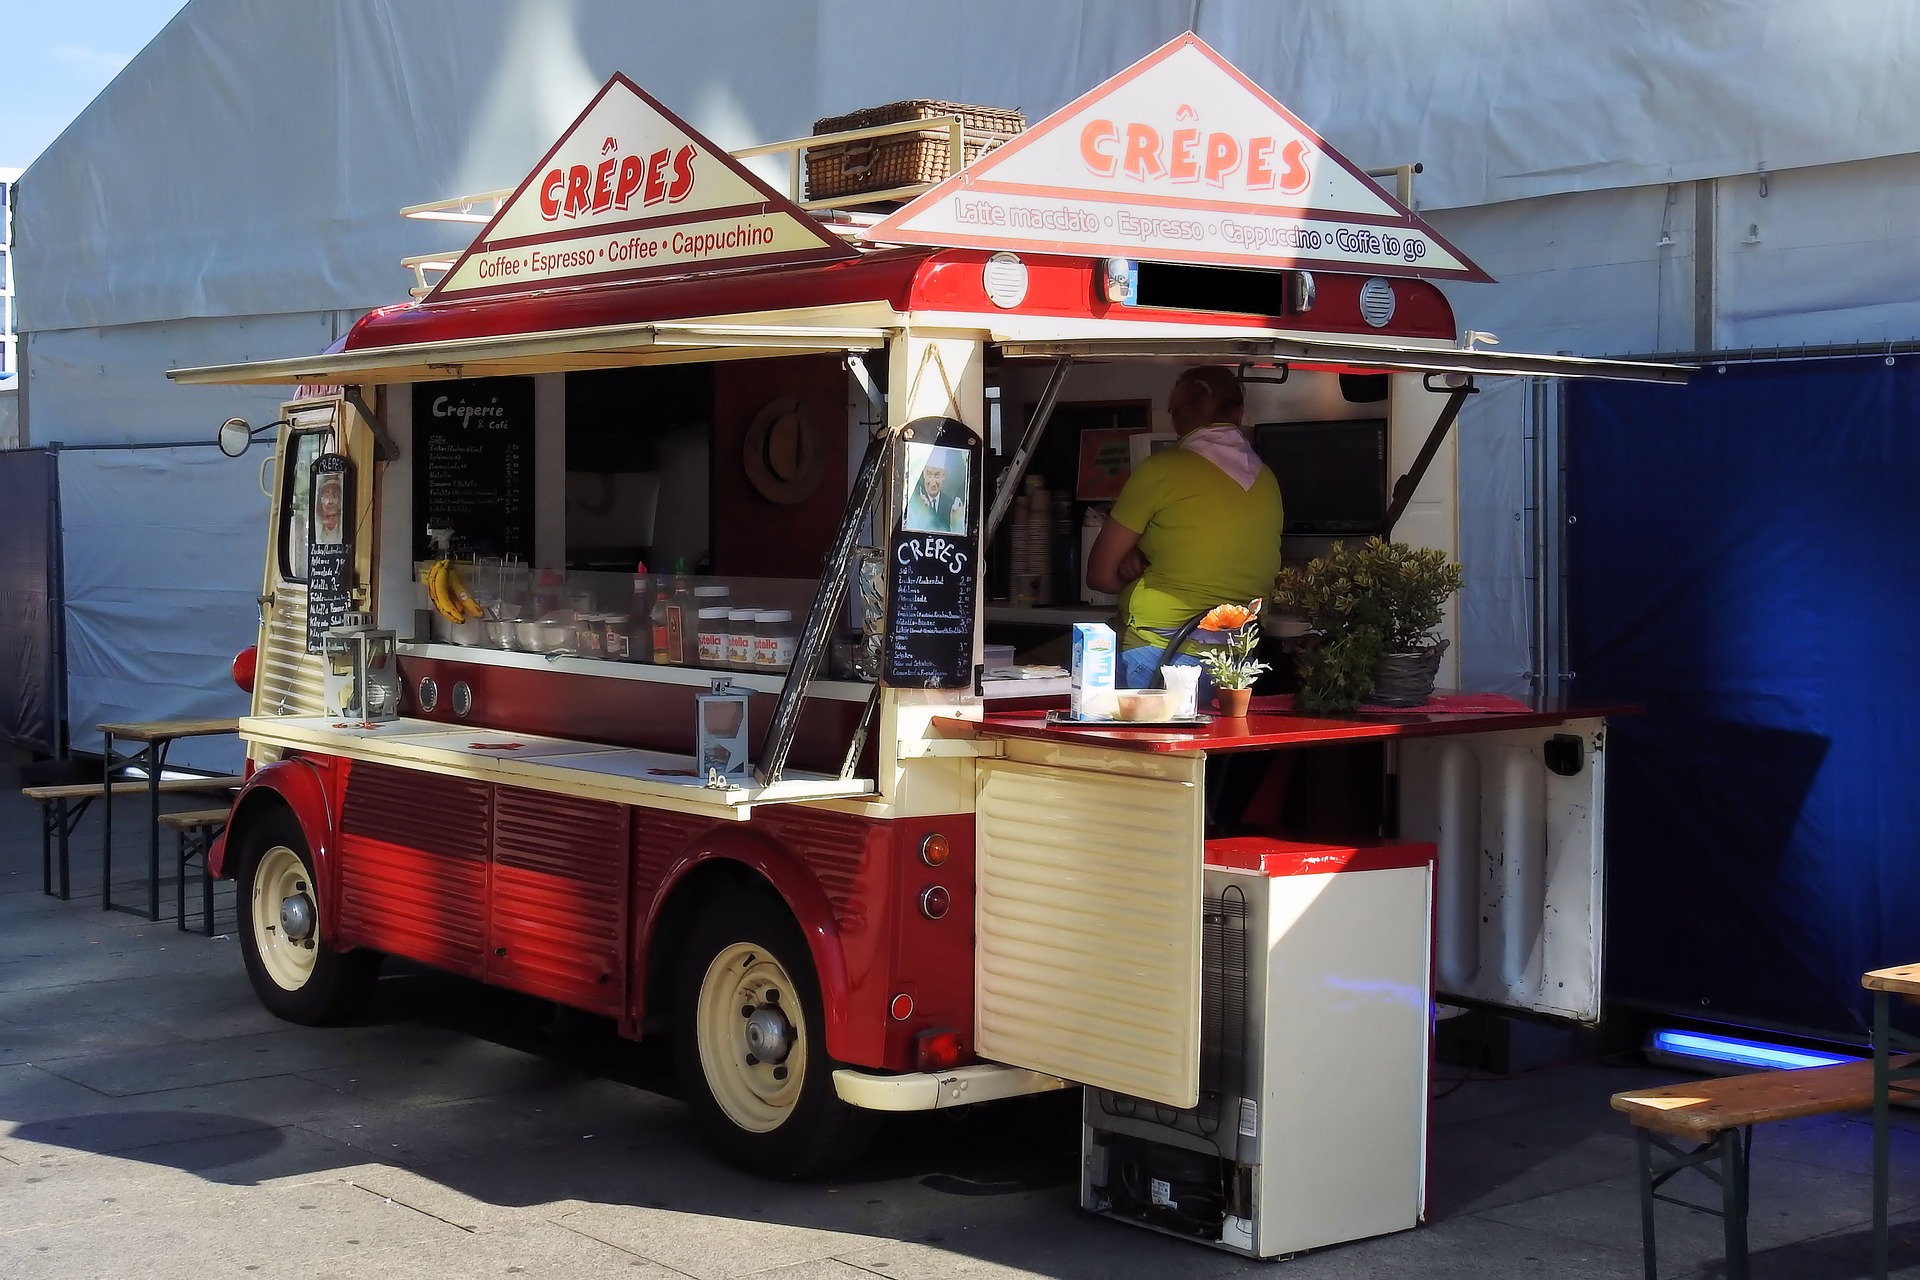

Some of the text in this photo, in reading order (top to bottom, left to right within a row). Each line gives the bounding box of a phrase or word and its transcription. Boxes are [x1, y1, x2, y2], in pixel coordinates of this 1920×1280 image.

[1079, 104, 1312, 195] CRÊPES
[540, 136, 698, 221] CRÊPES
[954, 197, 1426, 262] Latte macciato Espresso Cappuccino Coffe to go
[479, 223, 774, 279] Coffee Espresso Coffee Cappuchino
[432, 396, 504, 429] Crêperie
[489, 420, 509, 429] Café
[897, 535, 968, 574] CRÊPES
[698, 635, 721, 645] utella
[728, 637, 749, 647] utella
[753, 639, 778, 649] utella
